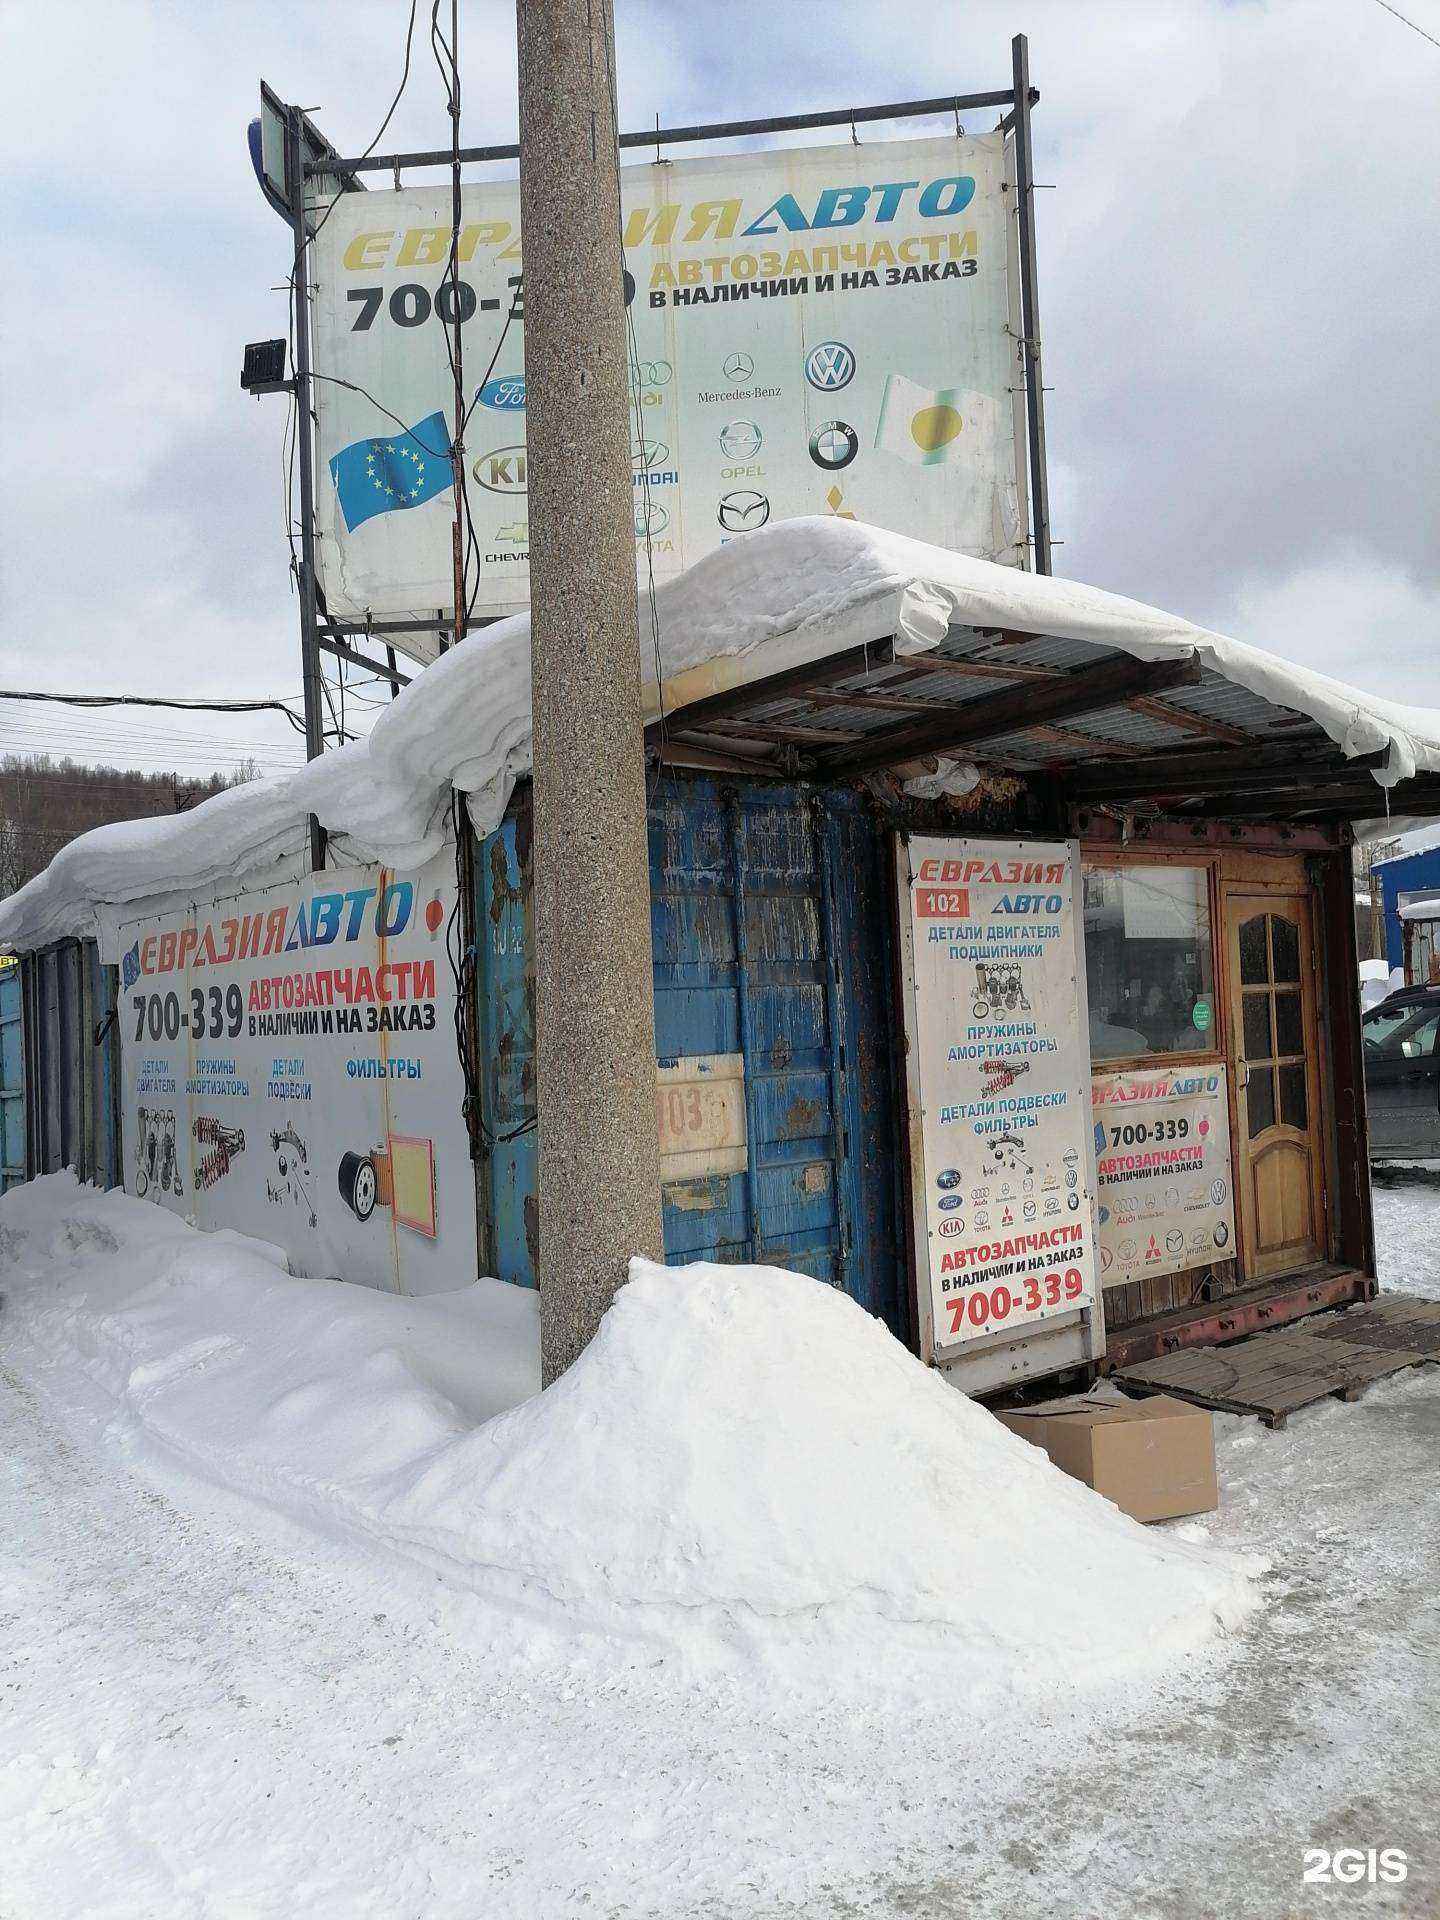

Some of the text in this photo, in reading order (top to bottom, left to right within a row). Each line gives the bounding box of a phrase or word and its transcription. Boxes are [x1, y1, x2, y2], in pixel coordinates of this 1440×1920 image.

[648, 231, 979, 288] АВТОЗАПЧАСТИ
[649, 258, 979, 308] В НАЛИЧИИ И НА ЗАКАЗ
[347, 266, 636, 331] 700-
[698, 386, 782, 403] Mercedes-Benz
[490, 457, 526, 484] KI
[720, 465, 766, 479] OPEL
[485, 552, 530, 563] CHEVR
[919, 859, 1065, 884] ЕВРАЗИЯ
[926, 893, 1063, 914] 102 АВТО
[928, 925, 1061, 942] ДЕТАЛИ ДВИГАТЕЛЯ
[949, 945, 1043, 961] ПОДШИПНИКИ
[248, 960, 436, 1012] АВТОЗАПЧАСТИ
[133, 984, 243, 1042] 700-339
[249, 1003, 437, 1037] В НАЛИЧИИ И НА ЗАКАЗ
[967, 1023, 1037, 1040] ПРУЖИНЫ
[947, 1038, 1058, 1062] АМОРТИЗАТОРЫ
[141, 1060, 169, 1075] ДЕТАЛИ
[196, 1059, 236, 1075] ПРУЖИНЫ
[272, 1059, 305, 1077] ДЕТАЛИ
[346, 1058, 422, 1080] ФИЛЬТРЫ
[185, 1080, 249, 1097] АМОРТИЗАТОРЫ
[267, 1081, 312, 1101] ПОДВЕСКИ
[940, 1092, 1067, 1124] ДЕТАЛИ ПОДВЕСКИ
[973, 1114, 1039, 1136] ФИЛЬТРЫ
[1110, 1118, 1189, 1147] 700-339
[1098, 1145, 1203, 1174] АВТОЗАПЧАСТИ
[1098, 1173, 1105, 1186] В
[1106, 1168, 1151, 1184] НАЛИЧИИ
[1161, 1164, 1174, 1176] НА
[1175, 1159, 1203, 1174] ЗАКАЗ
[942, 1220, 961, 1234] KIA
[940, 1223, 1083, 1273] АВТОЗАПЧАСТИ
[941, 1278, 951, 1291] В
[953, 1263, 1014, 1290] НАЛИЧИИ
[1016, 1260, 1026, 1273] И
[1028, 1256, 1046, 1271] НА
[1046, 1246, 1084, 1266] ЗАКАЗ
[946, 1268, 1083, 1334] 700-339
